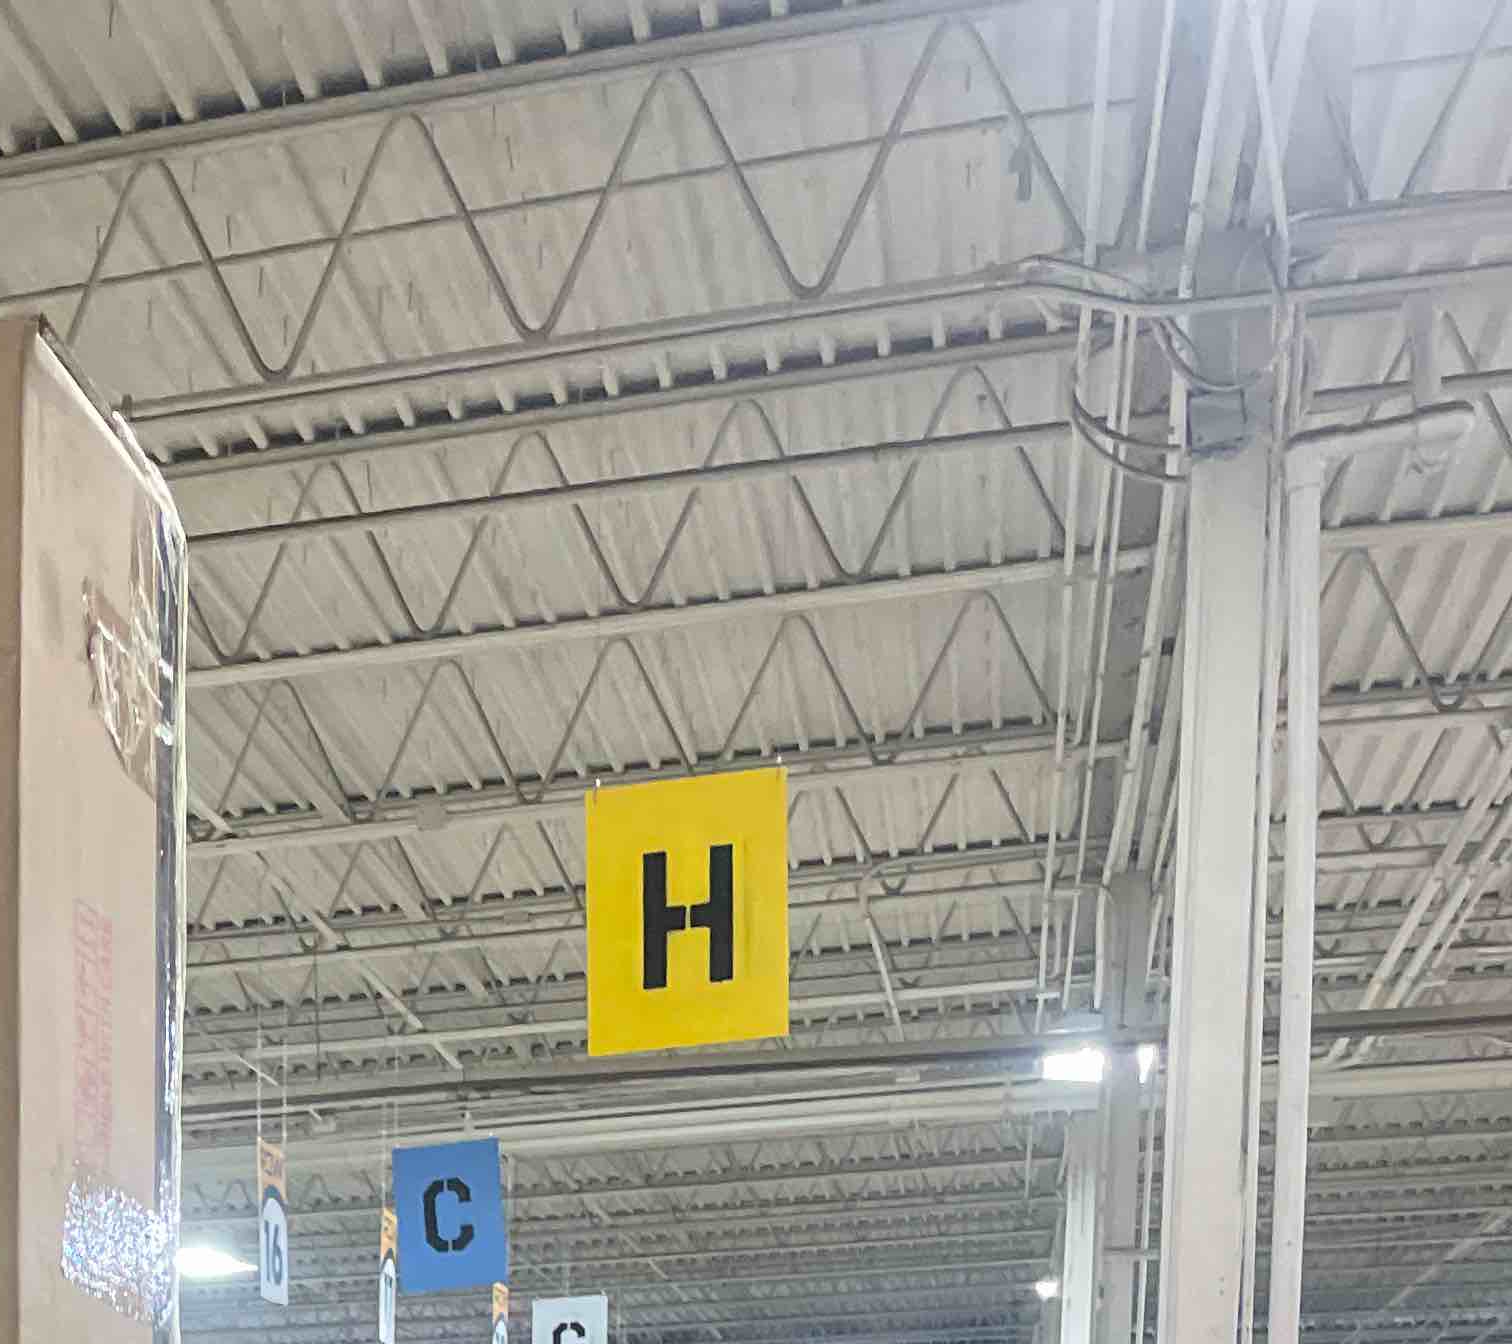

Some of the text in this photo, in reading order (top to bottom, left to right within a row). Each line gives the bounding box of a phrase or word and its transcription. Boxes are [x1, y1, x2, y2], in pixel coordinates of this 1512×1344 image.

[643, 843, 734, 990] H
[264, 1219, 283, 1286] 16
[422, 1178, 474, 1253] C
